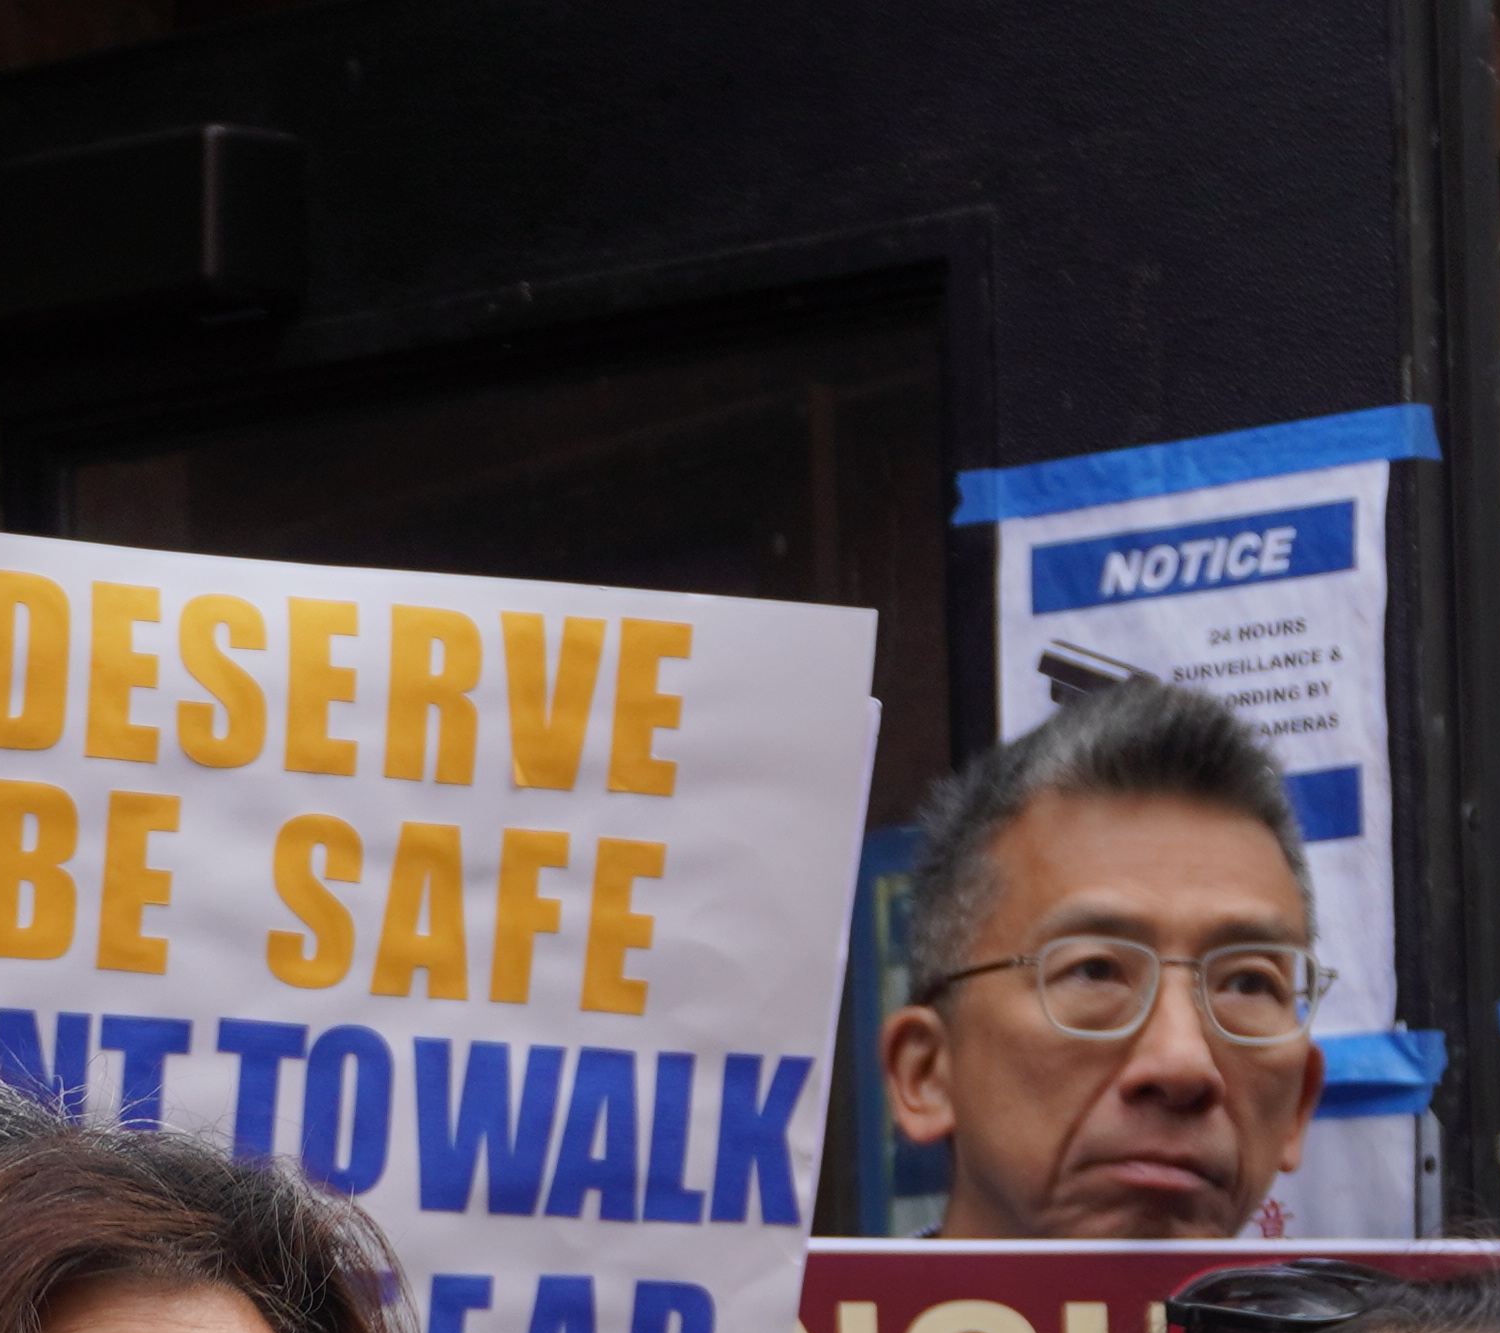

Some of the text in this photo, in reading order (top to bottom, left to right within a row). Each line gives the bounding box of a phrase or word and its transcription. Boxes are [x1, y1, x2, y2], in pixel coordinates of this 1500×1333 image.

[1101, 525, 1297, 597] NOTICE
[1209, 618, 1306, 646] 24 HOURS
[1173, 647, 1342, 682] SURVEILLANCE &
[1307, 681, 1332, 698] BY
[265, 815, 668, 1015] SAFE
